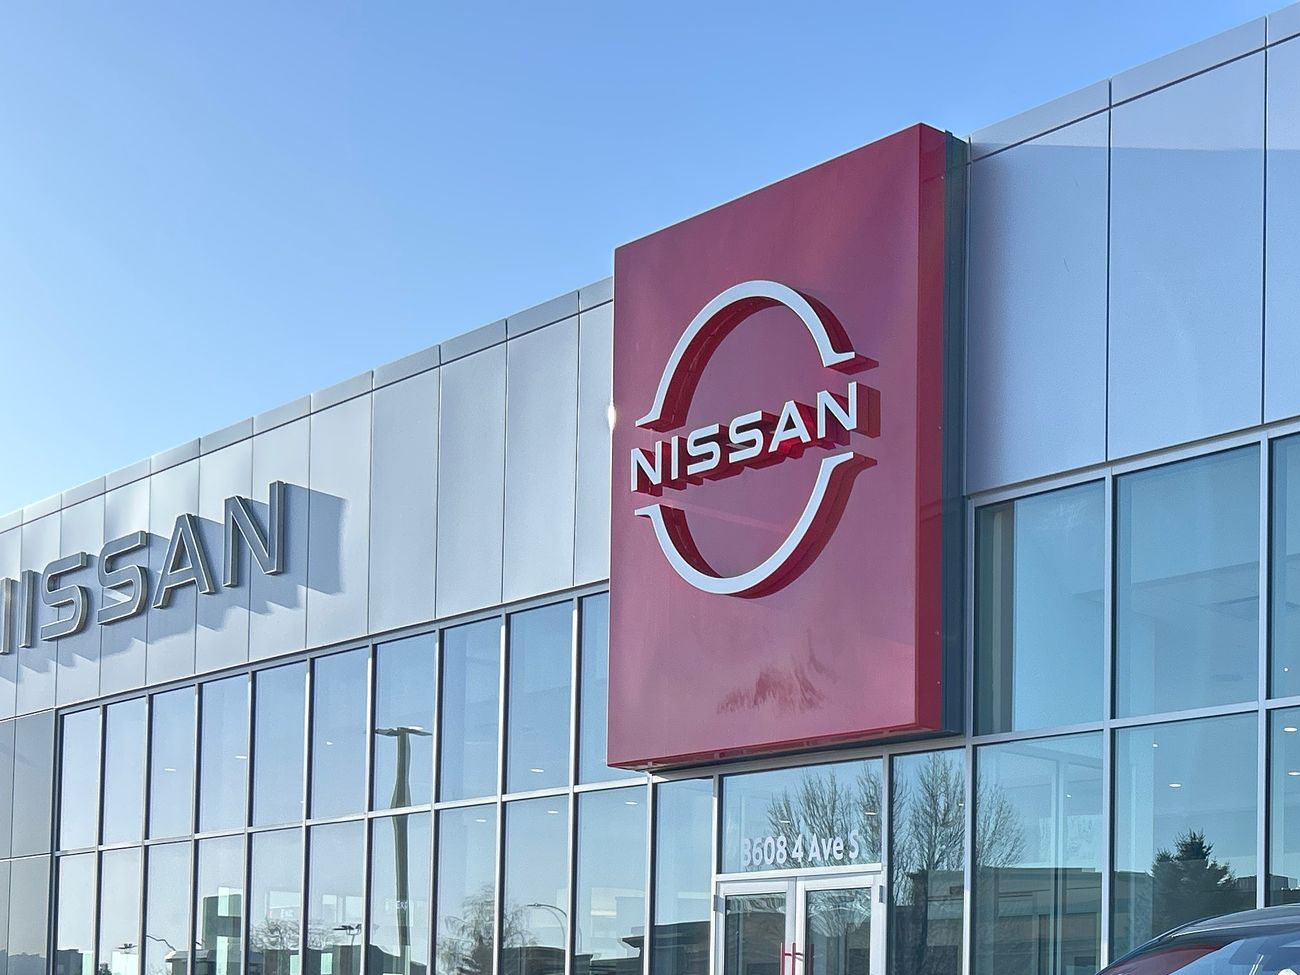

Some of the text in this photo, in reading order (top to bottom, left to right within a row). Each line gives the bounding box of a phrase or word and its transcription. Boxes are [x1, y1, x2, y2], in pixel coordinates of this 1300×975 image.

[630, 380, 858, 493] NISSAN
[0, 480, 285, 655] ISSAN
[791, 833, 804, 863] 4
[808, 832, 844, 862] Ave
[847, 828, 860, 860] S
